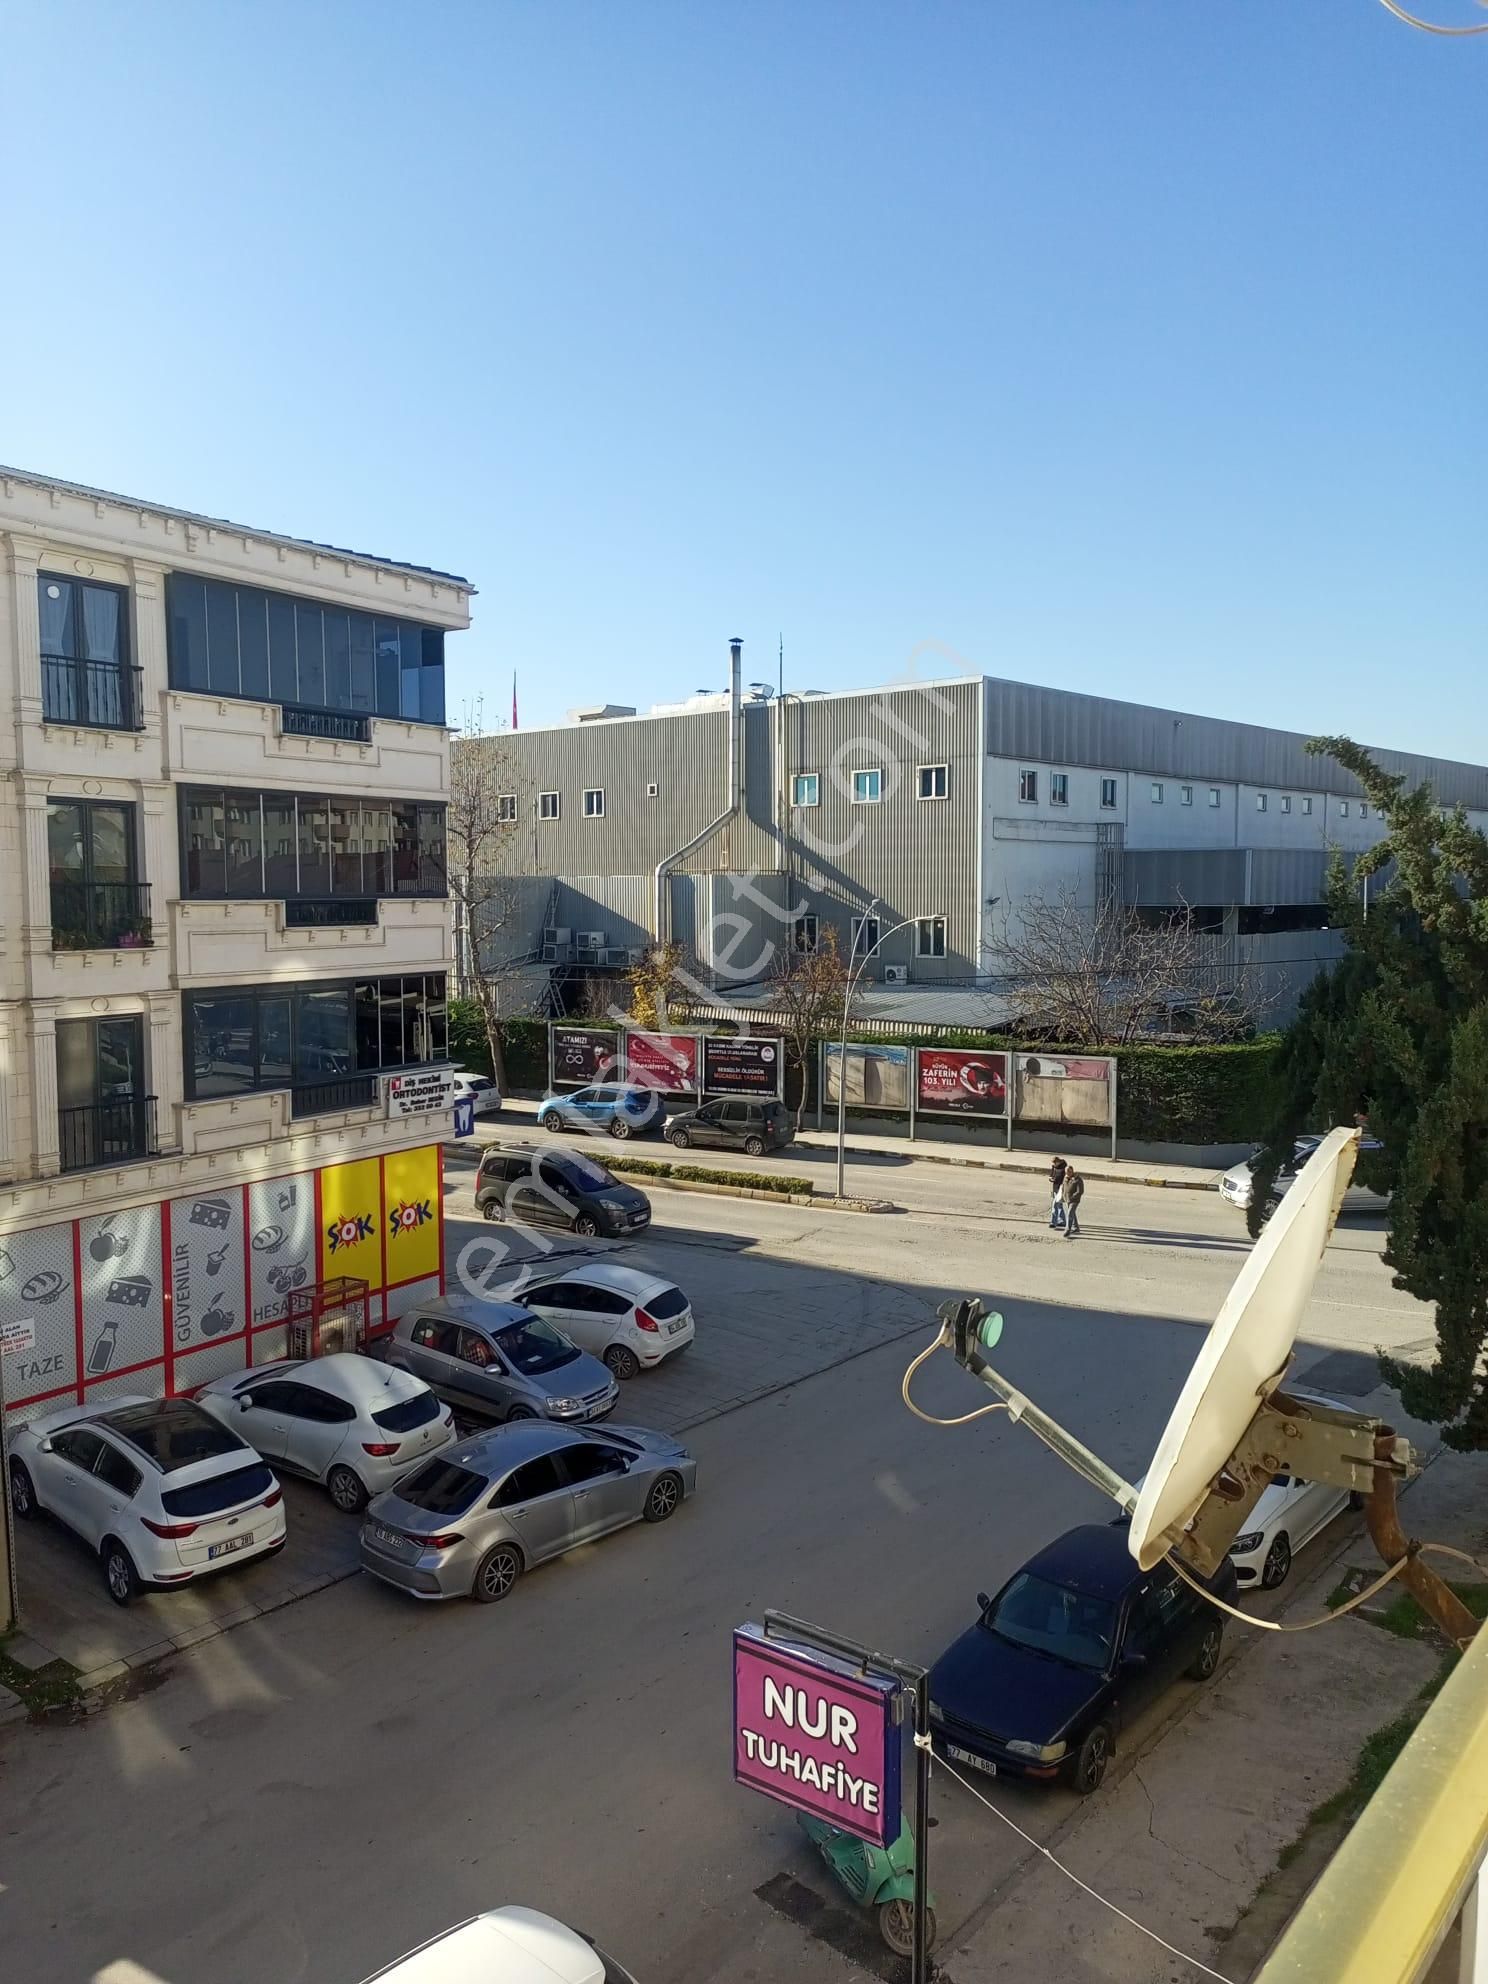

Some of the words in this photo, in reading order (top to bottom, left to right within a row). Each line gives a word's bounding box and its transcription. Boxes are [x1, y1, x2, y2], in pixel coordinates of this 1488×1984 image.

[404, 1077, 416, 1087] DİŞ
[922, 1068, 958, 1078] ZAFERİN
[924, 1077, 940, 1085] 103.
[942, 1078, 956, 1086] YILI
[392, 1082, 452, 1100] ORTODONTİST
[327, 1213, 376, 1255] ŞOK
[389, 1199, 433, 1239] ŞOK
[172, 1242, 191, 1342] GÜVENİLİR
[15, 1354, 64, 1380] TAZE
[763, 1676, 857, 1754] NUR
[741, 1728, 880, 1814] TUHAFİYE
